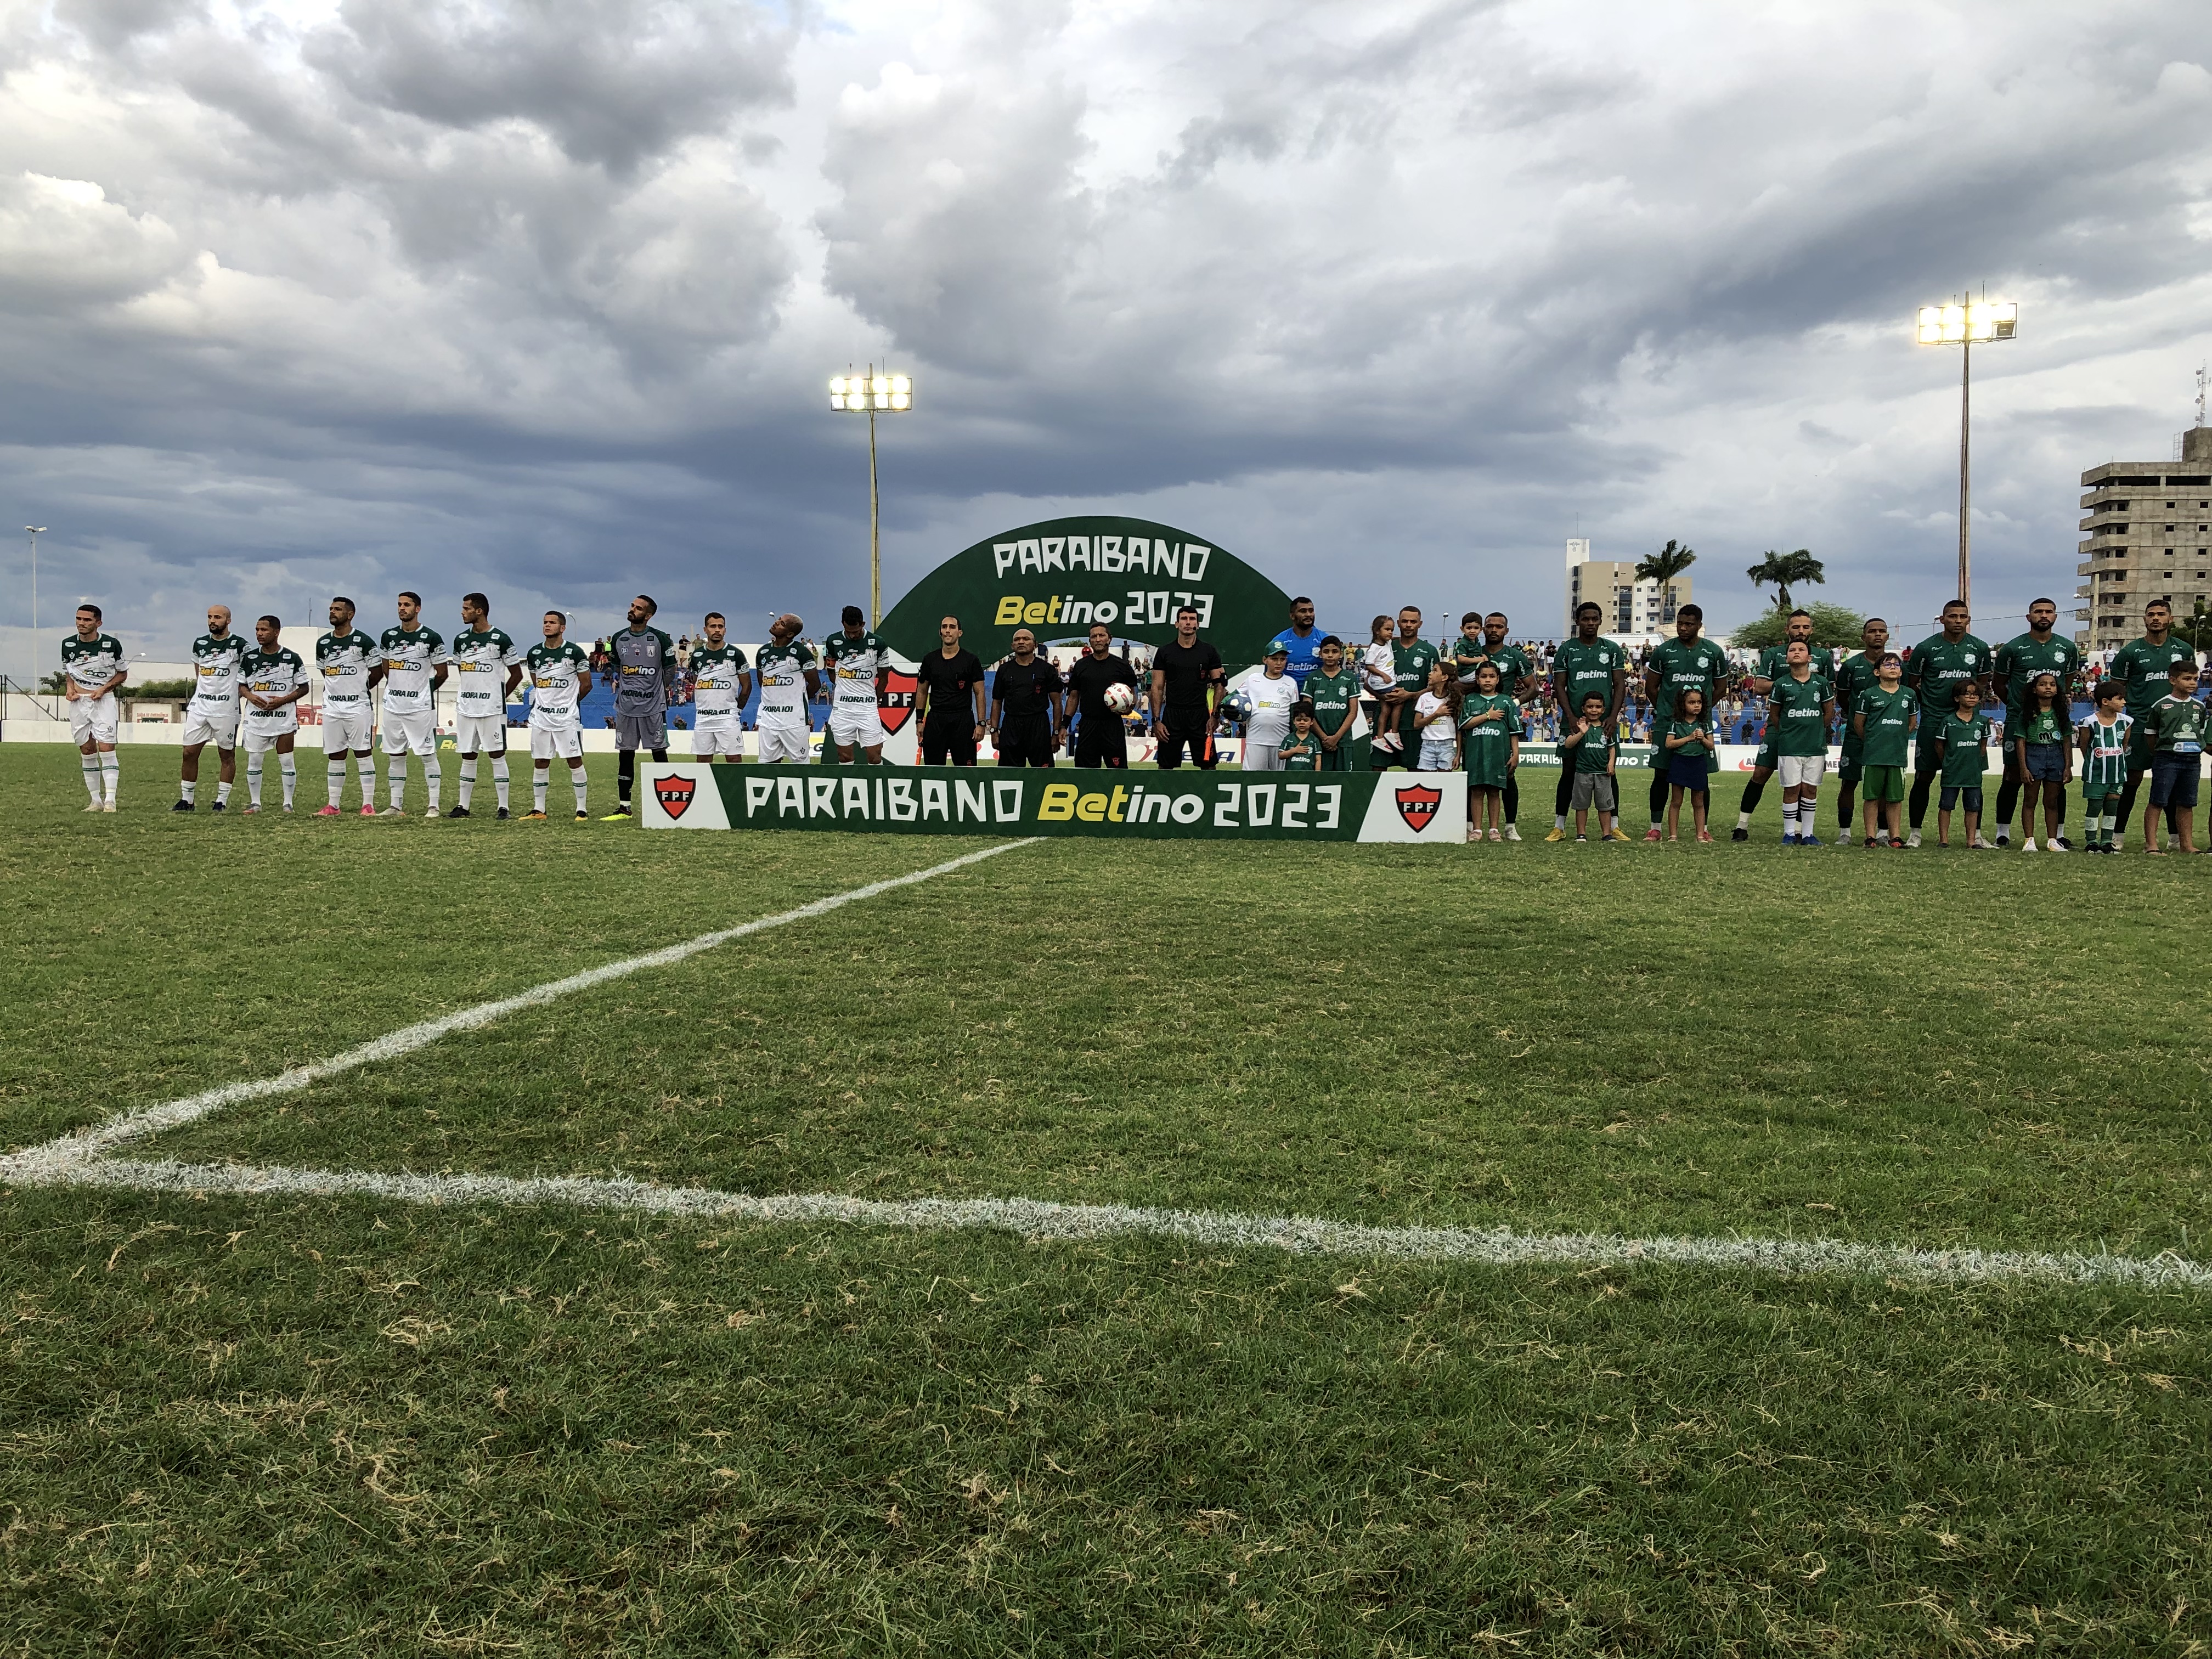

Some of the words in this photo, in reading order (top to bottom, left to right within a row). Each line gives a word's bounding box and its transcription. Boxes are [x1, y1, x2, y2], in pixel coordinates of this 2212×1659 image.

[993, 535, 1211, 582] PARAIBANO
[994, 595, 1119, 625] Betino
[1125, 591, 1214, 629] 2023
[623, 665, 656, 675] Betino
[1286, 663, 1319, 671] Betino
[838, 668, 872, 679] Betino
[1576, 670, 1607, 680] Betino
[1672, 673, 1706, 682] Betino
[1938, 669, 1971, 679] Betino
[2145, 670, 2169, 682] Beti
[696, 679, 730, 689] Betino
[1258, 701, 1280, 709] Betino
[1315, 701, 1347, 710] Betino
[1787, 708, 1820, 718] Betino
[1472, 726, 1500, 737] Betino
[662, 791, 691, 802] FPF
[745, 776, 1024, 822] PARAIBANO
[1037, 783, 1204, 824] Betino
[1213, 783, 1342, 829] 2023
[1402, 801, 1435, 814] FPF
